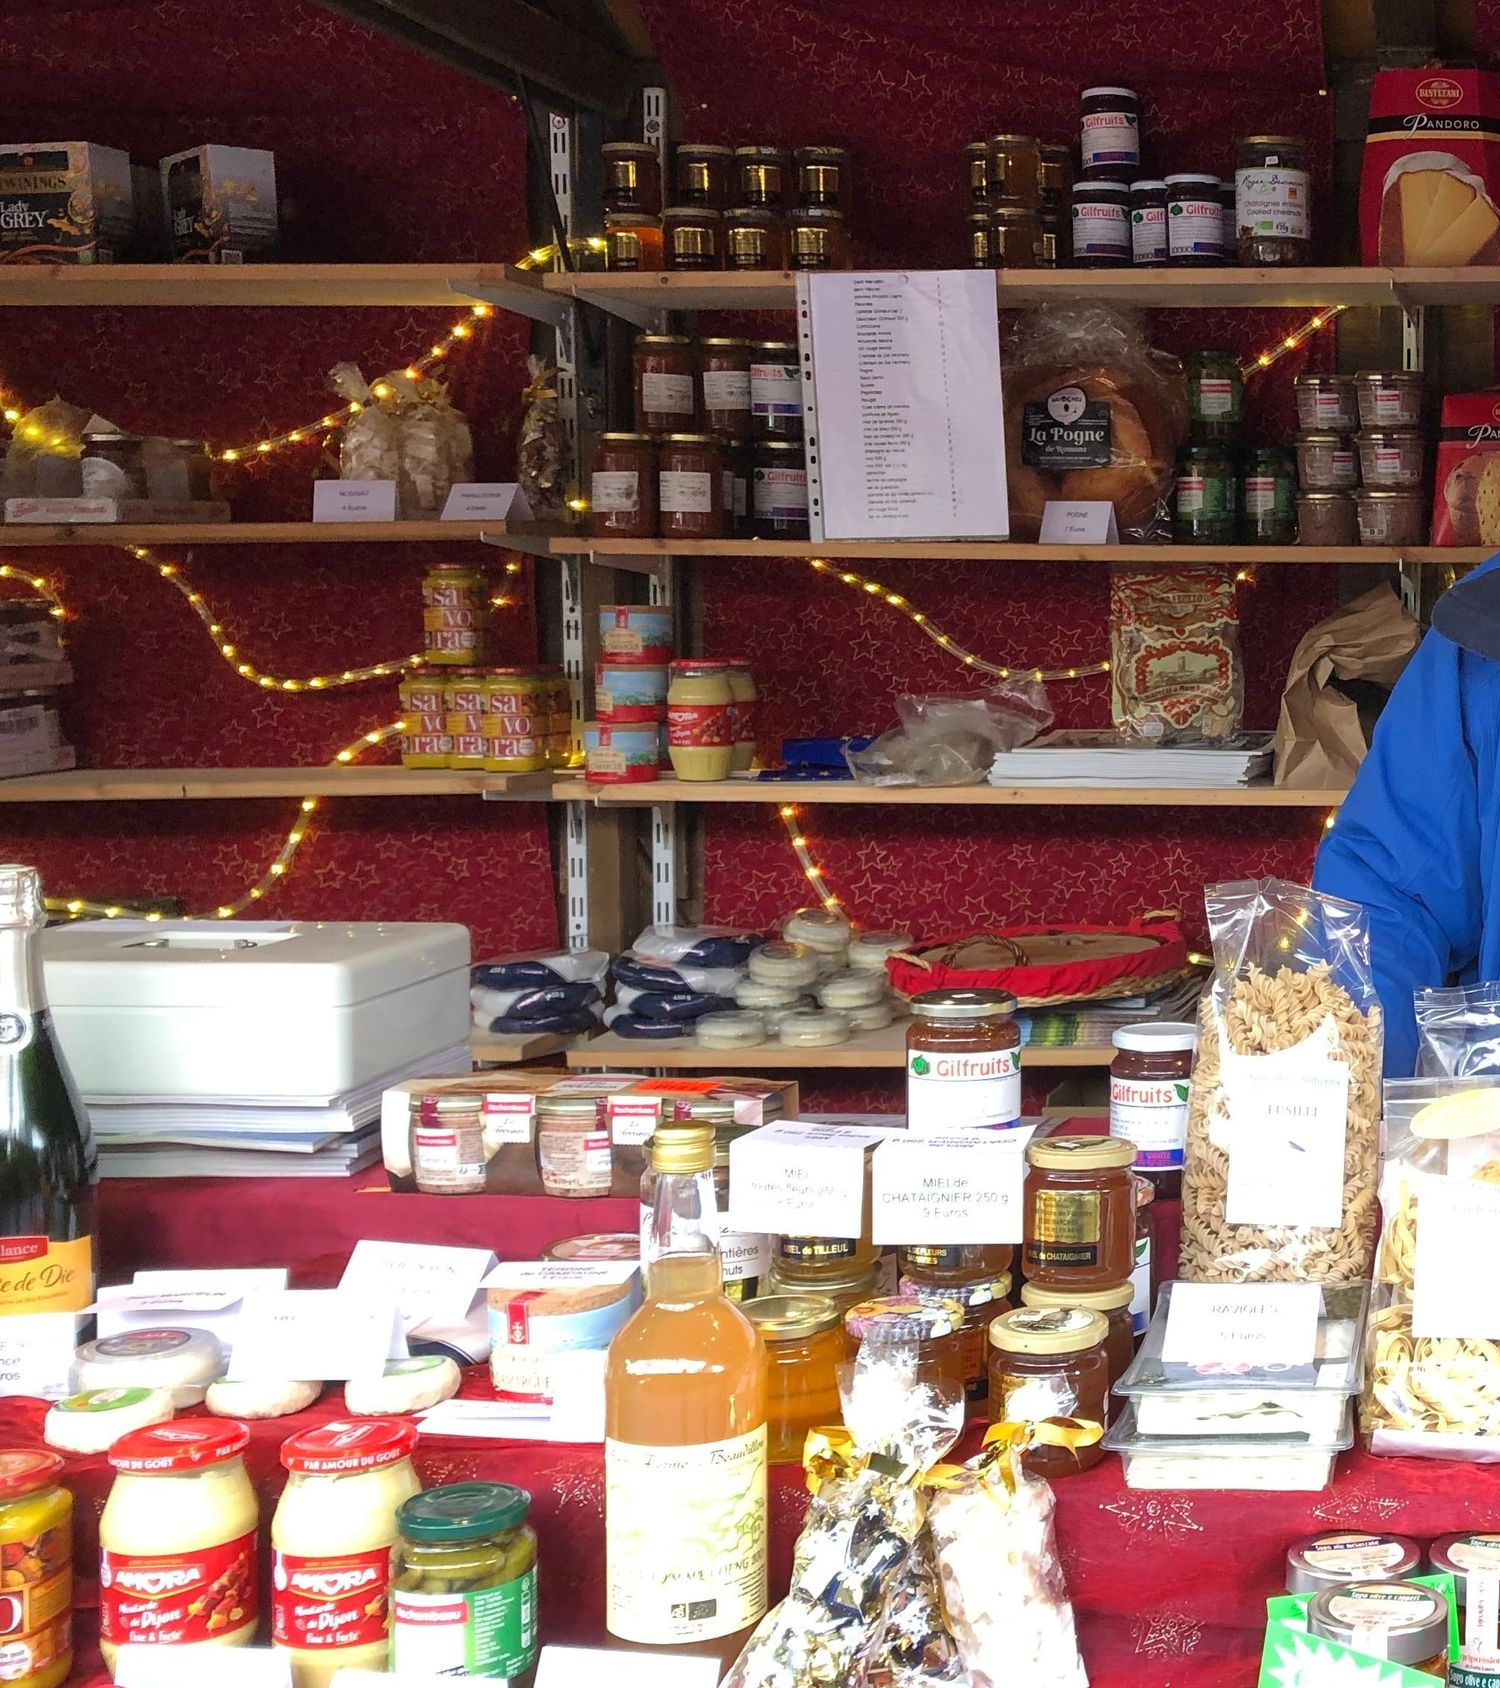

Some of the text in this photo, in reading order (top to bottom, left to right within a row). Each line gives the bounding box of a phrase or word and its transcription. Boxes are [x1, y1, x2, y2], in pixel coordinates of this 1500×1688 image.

[1085, 116, 1125, 128] Gilfruits
[1080, 206, 1121, 219] Gilfruits
[0, 211, 48, 229] GREY
[1028, 427, 1105, 446] La Pogne
[936, 1057, 1010, 1079] Gilfruits
[1111, 1083, 1174, 1104] Gilfruits
[882, 1192, 1009, 1205] CHATAIGNIER 250 g
[934, 1209, 969, 1218] Euros
[813, 1244, 849, 1254] TILLEUL
[922, 1247, 948, 1257] FLEURS
[1046, 1251, 1092, 1261] CHATAIGNIER
[15, 1264, 74, 1292] de Die
[303, 1448, 402, 1470] PAR AMOUR DU GOÛT
[115, 1567, 201, 1595] AMORA
[290, 1566, 377, 1594] AMORA
[1350, 1591, 1369, 1601] Sugo
[1369, 1592, 1386, 1600] olive
[1393, 1594, 1420, 1602] capperi
[118, 1602, 158, 1615] Moutarde
[294, 1602, 336, 1616] Moutarde
[129, 1608, 182, 1630] de Dijon
[306, 1608, 360, 1630] de Dijon
[128, 1631, 146, 1641] Fine
[158, 1629, 184, 1641] Forte
[305, 1632, 323, 1644] Fine
[335, 1630, 361, 1643] Forte
[1450, 1671, 1464, 1684] Sugo
[1464, 1671, 1480, 1687] olive
